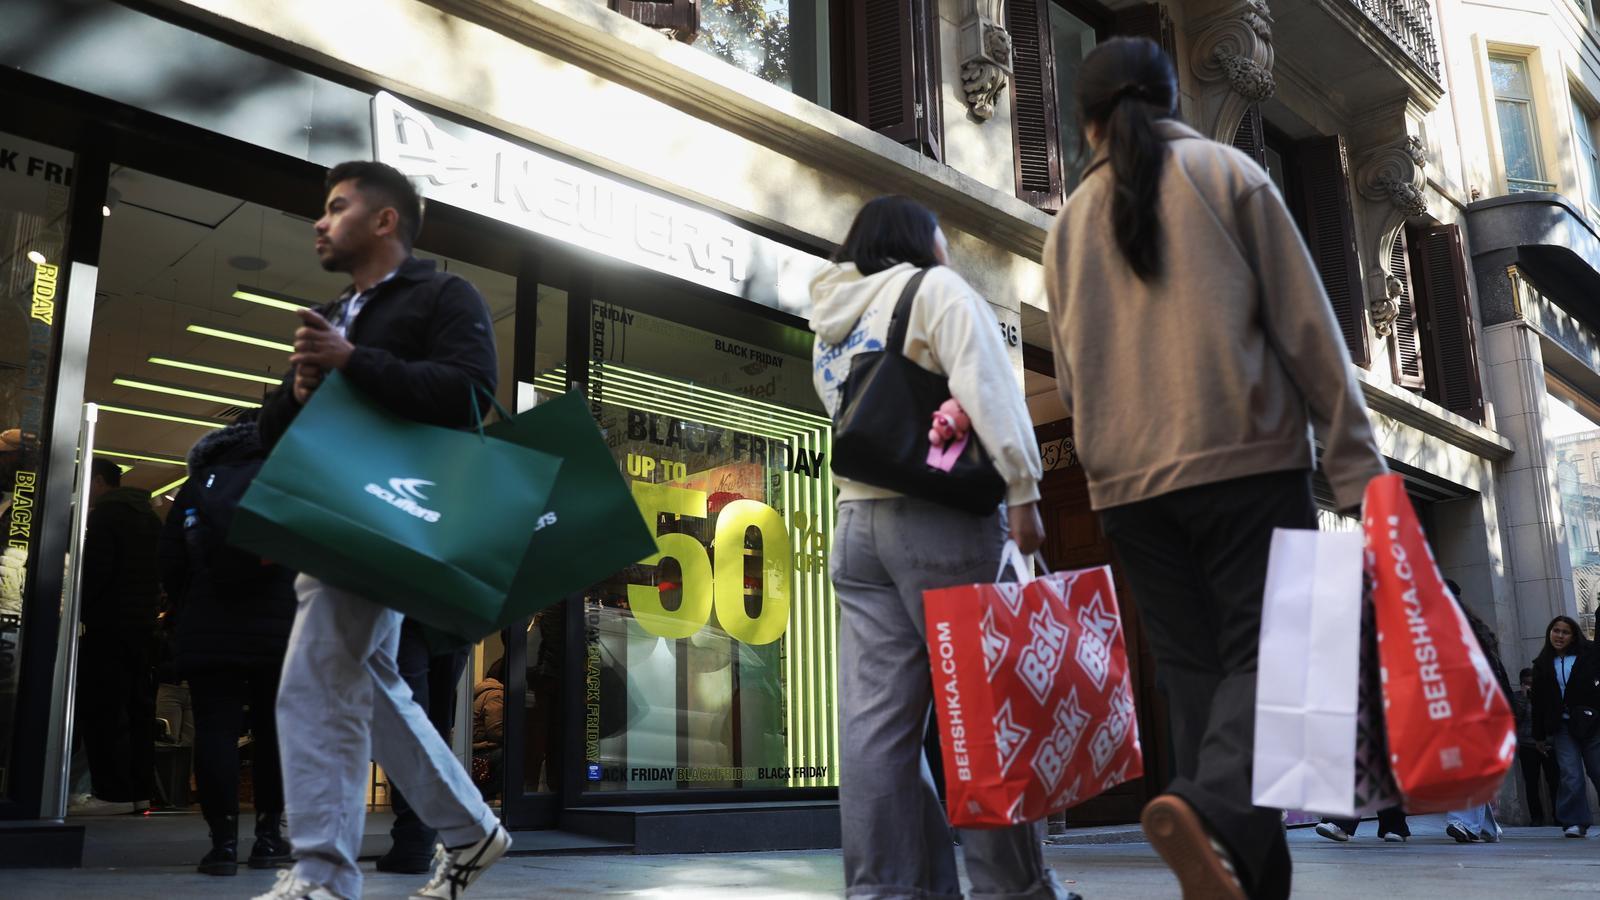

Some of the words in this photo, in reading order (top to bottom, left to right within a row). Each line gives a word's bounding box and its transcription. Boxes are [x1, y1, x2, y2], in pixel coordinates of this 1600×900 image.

[493, 152, 615, 240] NEW
[634, 202, 743, 284] ERA
[31, 263, 58, 325] RIDAY
[592, 304, 635, 326] FRIDAY
[715, 339, 748, 360] BLACK
[750, 348, 784, 369] FRIDAY
[627, 410, 732, 456] BLACK
[733, 431, 825, 479] FRIDAY
[627, 453, 656, 478] UP
[660, 458, 687, 483] TO
[9, 470, 36, 537] BLACK
[626, 480, 790, 645] 50
[794, 552, 827, 575] OFF
[587, 645, 601, 701] BLACK
[1020, 607, 1067, 699] BSK
[1077, 601, 1118, 688] BSK
[586, 703, 600, 763] FRIDAY
[936, 622, 972, 781] BERSHKA.COM
[602, 768, 628, 782] ACK
[631, 767, 675, 781] FRIDAY
[758, 766, 790, 780] BLACK
[793, 765, 827, 779] FRIDAY
[1036, 694, 1087, 790] BSK
